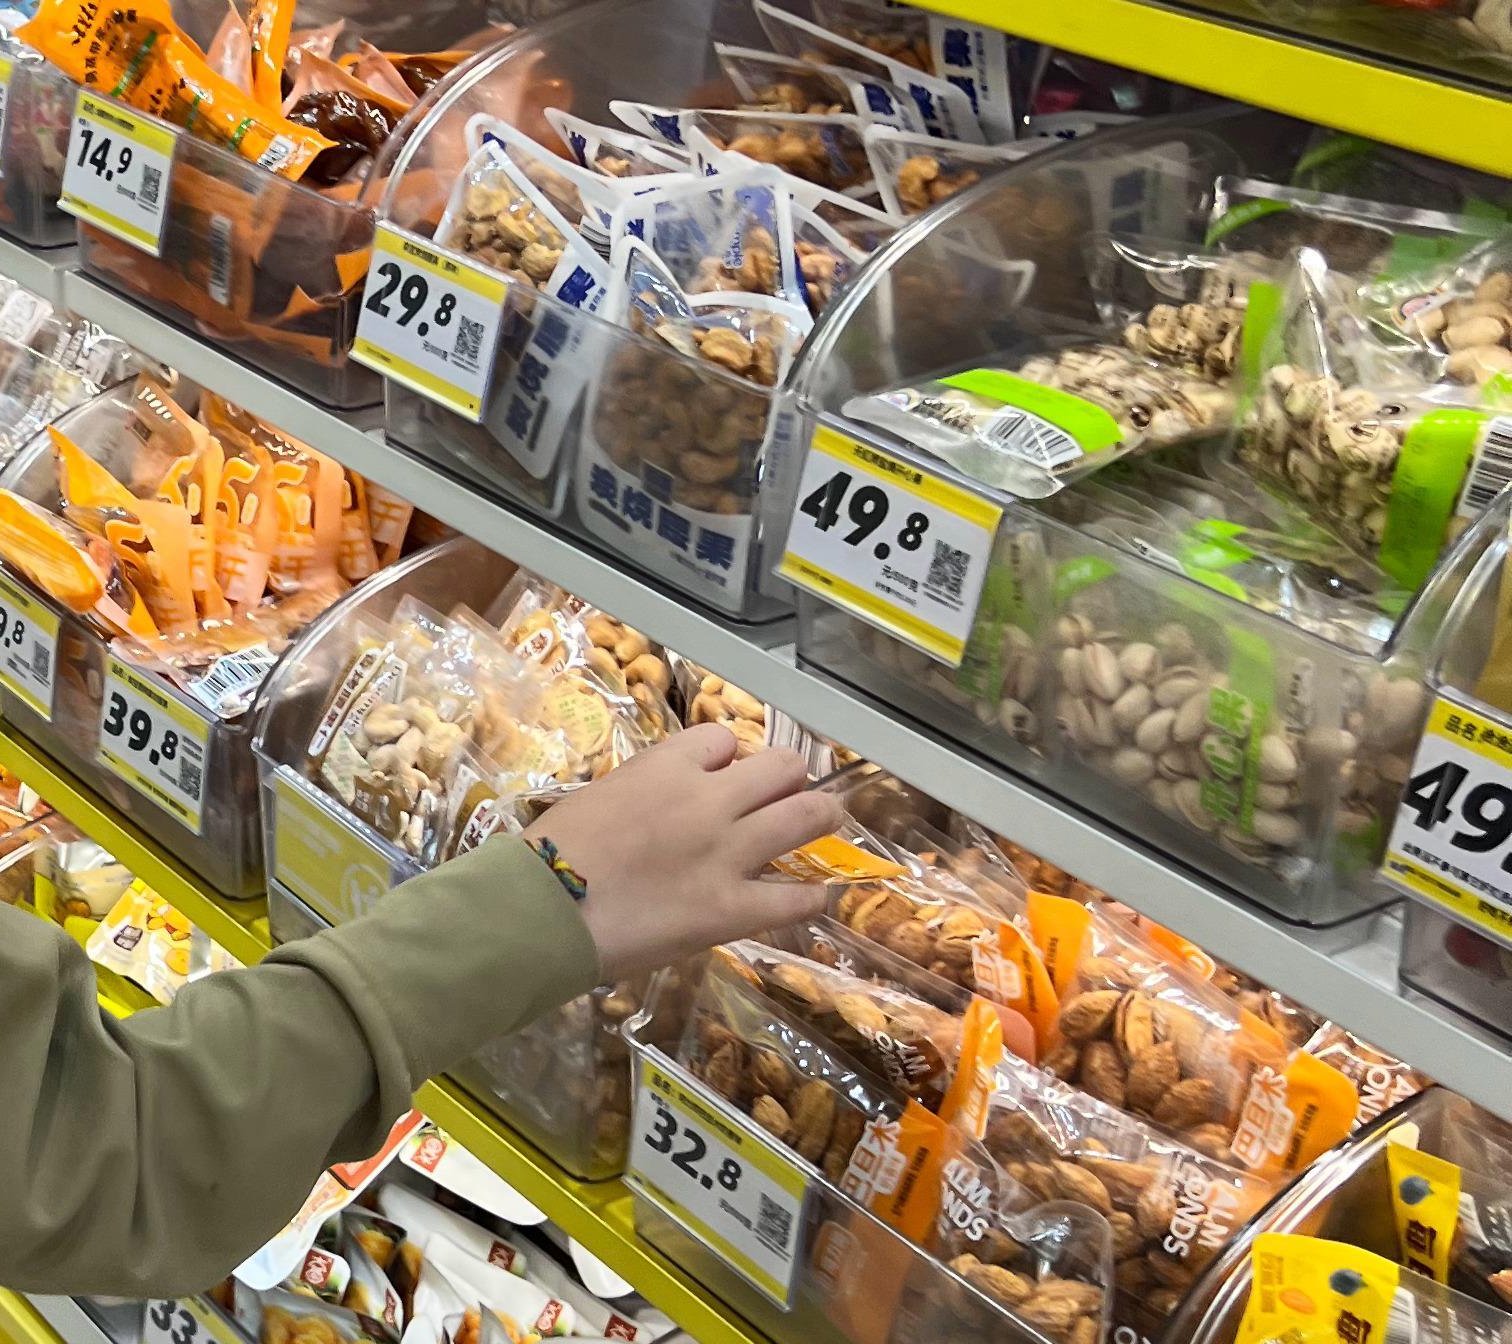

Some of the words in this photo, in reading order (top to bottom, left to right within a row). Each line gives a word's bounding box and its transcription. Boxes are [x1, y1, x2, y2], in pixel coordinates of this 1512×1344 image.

[79, 129, 132, 181] 14.9
[365, 262, 457, 337] 29.8
[800, 471, 929, 560] 49.8
[103, 692, 178, 765] 39.8
[645, 1107, 742, 1191] 32.8
